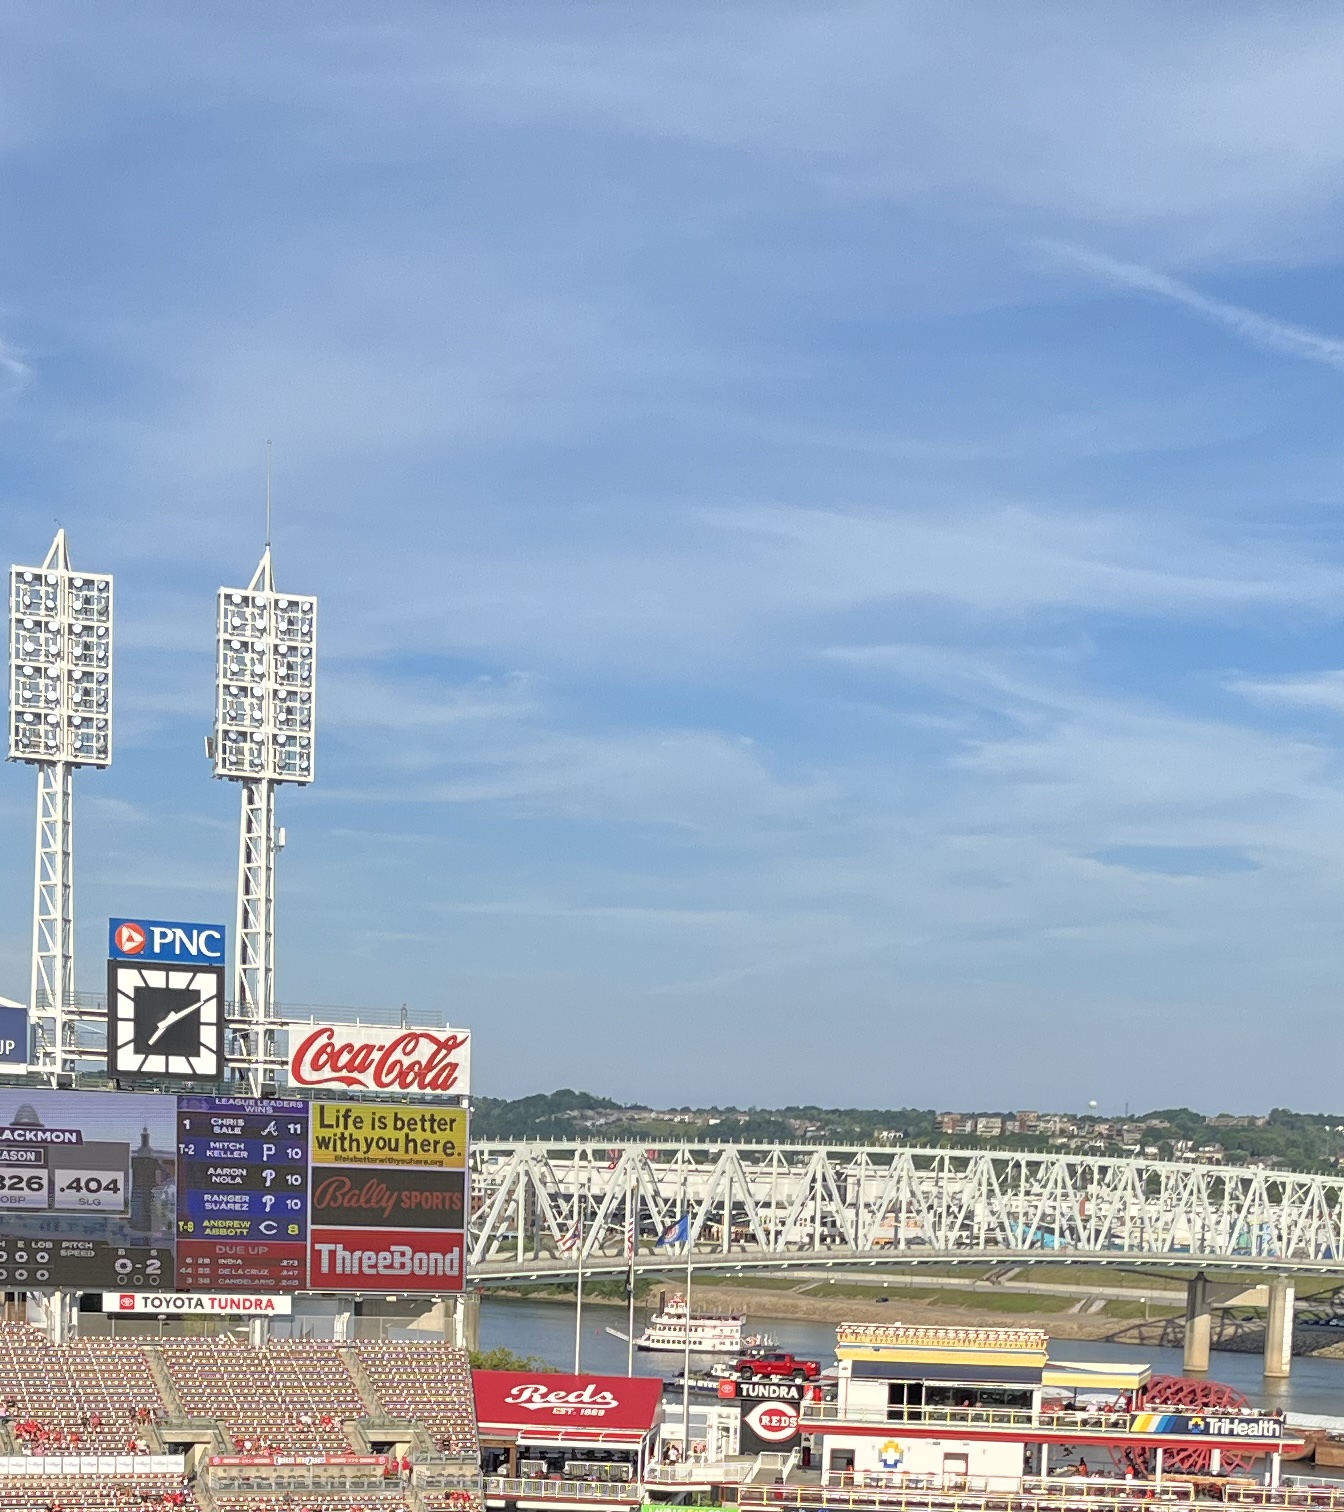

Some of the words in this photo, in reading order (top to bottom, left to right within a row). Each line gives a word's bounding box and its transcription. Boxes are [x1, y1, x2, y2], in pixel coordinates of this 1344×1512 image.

[150, 926, 221, 957] PNC
[291, 1027, 469, 1092] Coca-Cola
[215, 1098, 256, 1106] LEAGUE
[257, 1100, 304, 1108] LEADERS
[210, 1117, 245, 1126] CHRIS
[319, 1104, 364, 1131] Life
[371, 1111, 388, 1131] is
[393, 1112, 457, 1134] better
[210, 1142, 245, 1150] MITCH
[315, 1131, 361, 1153] with
[363, 1135, 399, 1155] you
[404, 1132, 462, 1157] here.
[206, 1150, 249, 1158] KELLER
[207, 1167, 247, 1176] AARON
[59, 1177, 121, 1195] .404
[211, 1175, 243, 1184] NOLA
[203, 1195, 250, 1203] RANGER
[314, 1176, 399, 1218] Bally
[400, 1191, 462, 1211] SPORTS
[202, 1220, 251, 1228] ANDREW
[204, 1228, 249, 1236] ABBOTT
[61, 1241, 93, 1249] PITCH
[314, 1243, 460, 1277] ThreeBond
[141, 1296, 205, 1310] TOYOTA
[208, 1297, 276, 1311] TUNDRA
[504, 1383, 619, 1411] Reds
[740, 1383, 799, 1399] TUNDRA
[552, 1407, 577, 1416] EST.
[760, 1415, 798, 1428] REDS
[1206, 1417, 1280, 1437] TriHealth
